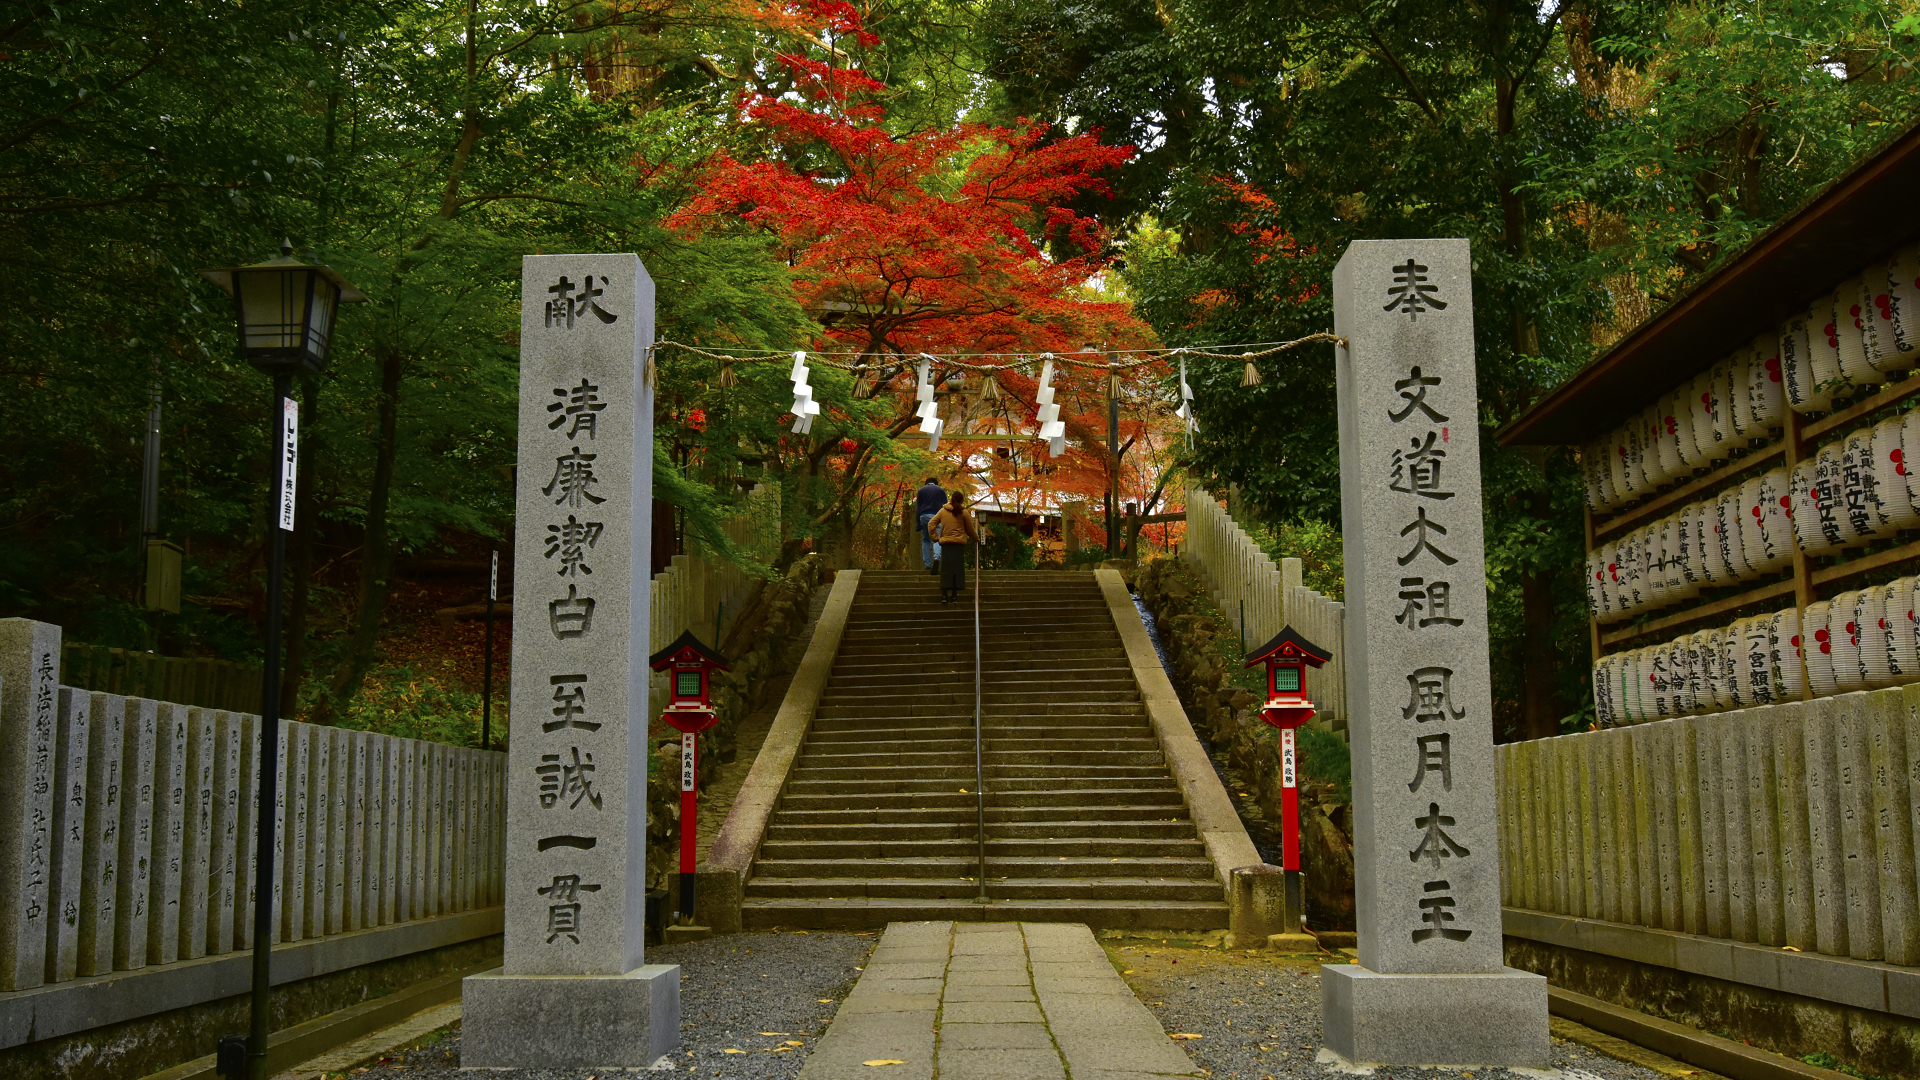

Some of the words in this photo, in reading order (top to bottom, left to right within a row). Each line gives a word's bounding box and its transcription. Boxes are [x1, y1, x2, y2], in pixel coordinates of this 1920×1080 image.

[544, 275, 617, 329] 献
[1383, 258, 1447, 322] 奉
[542, 378, 607, 640] 清廉潔白
[1388, 365, 1464, 631] 文道大祖
[536, 674, 602, 944] 至誠一貫
